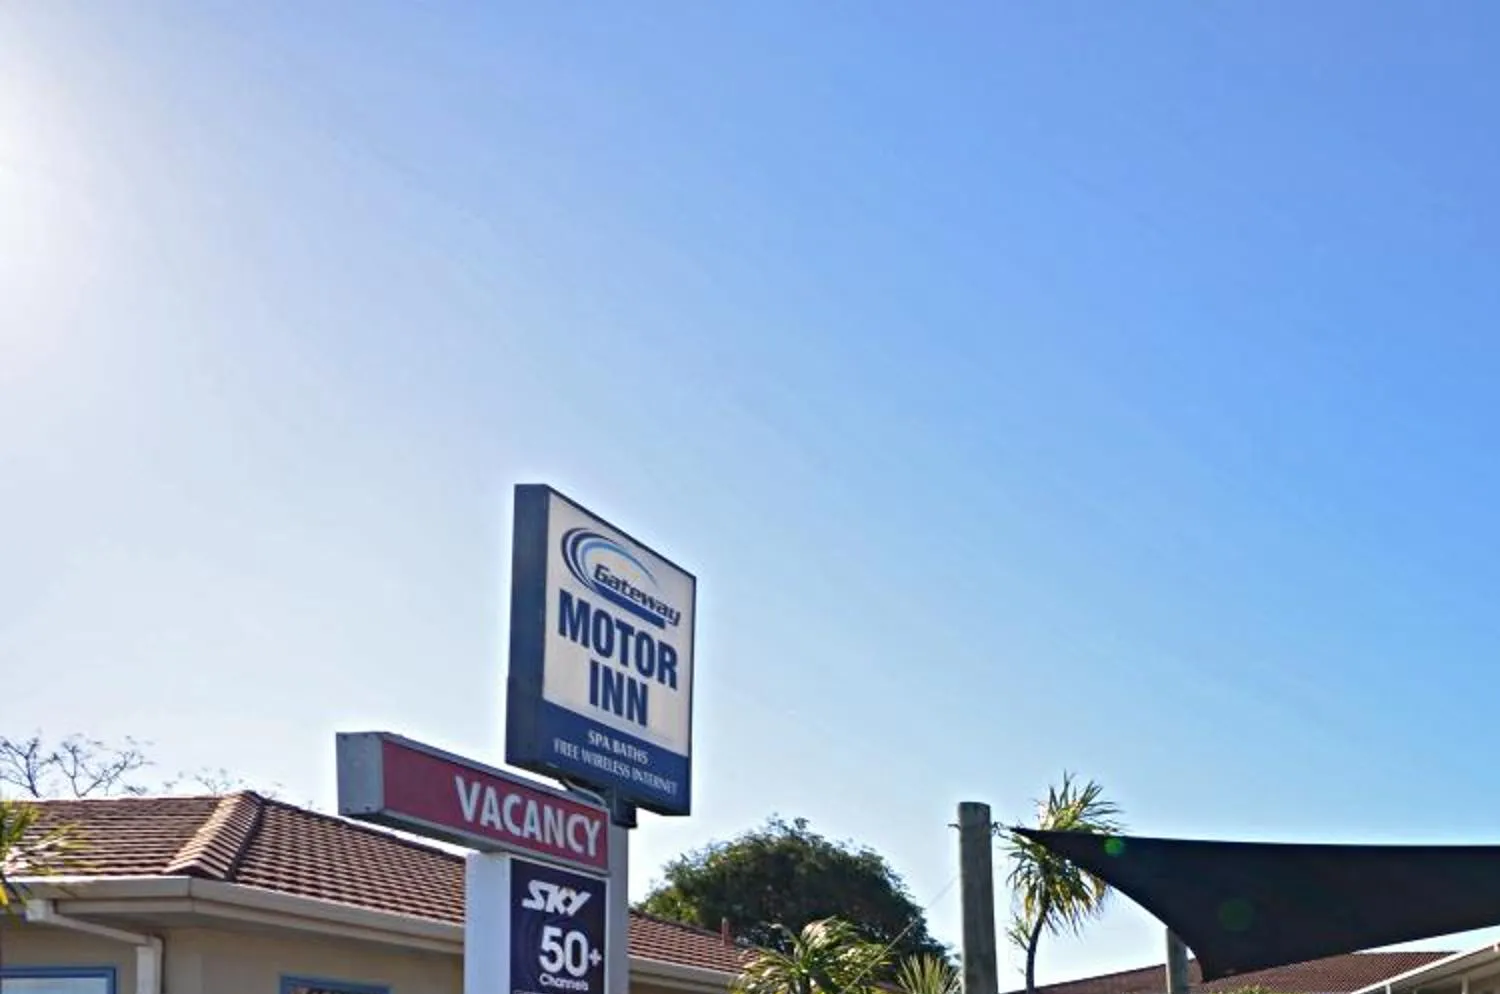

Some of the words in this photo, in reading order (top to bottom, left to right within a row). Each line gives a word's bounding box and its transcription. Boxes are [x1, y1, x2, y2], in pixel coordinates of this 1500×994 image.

[593, 563, 681, 627] Gateway
[558, 588, 678, 690] MOTOR
[589, 659, 649, 728] INN
[553, 738, 578, 760] FREE
[581, 748, 630, 778] WIRELESS
[631, 767, 678, 795] INTERNET
[587, 729, 610, 751] SPA
[612, 739, 649, 764] BATHS
[455, 776, 600, 856] VACANCY
[521, 879, 592, 916] SKY
[538, 926, 602, 978] 50+
[539, 972, 589, 991] Channels
